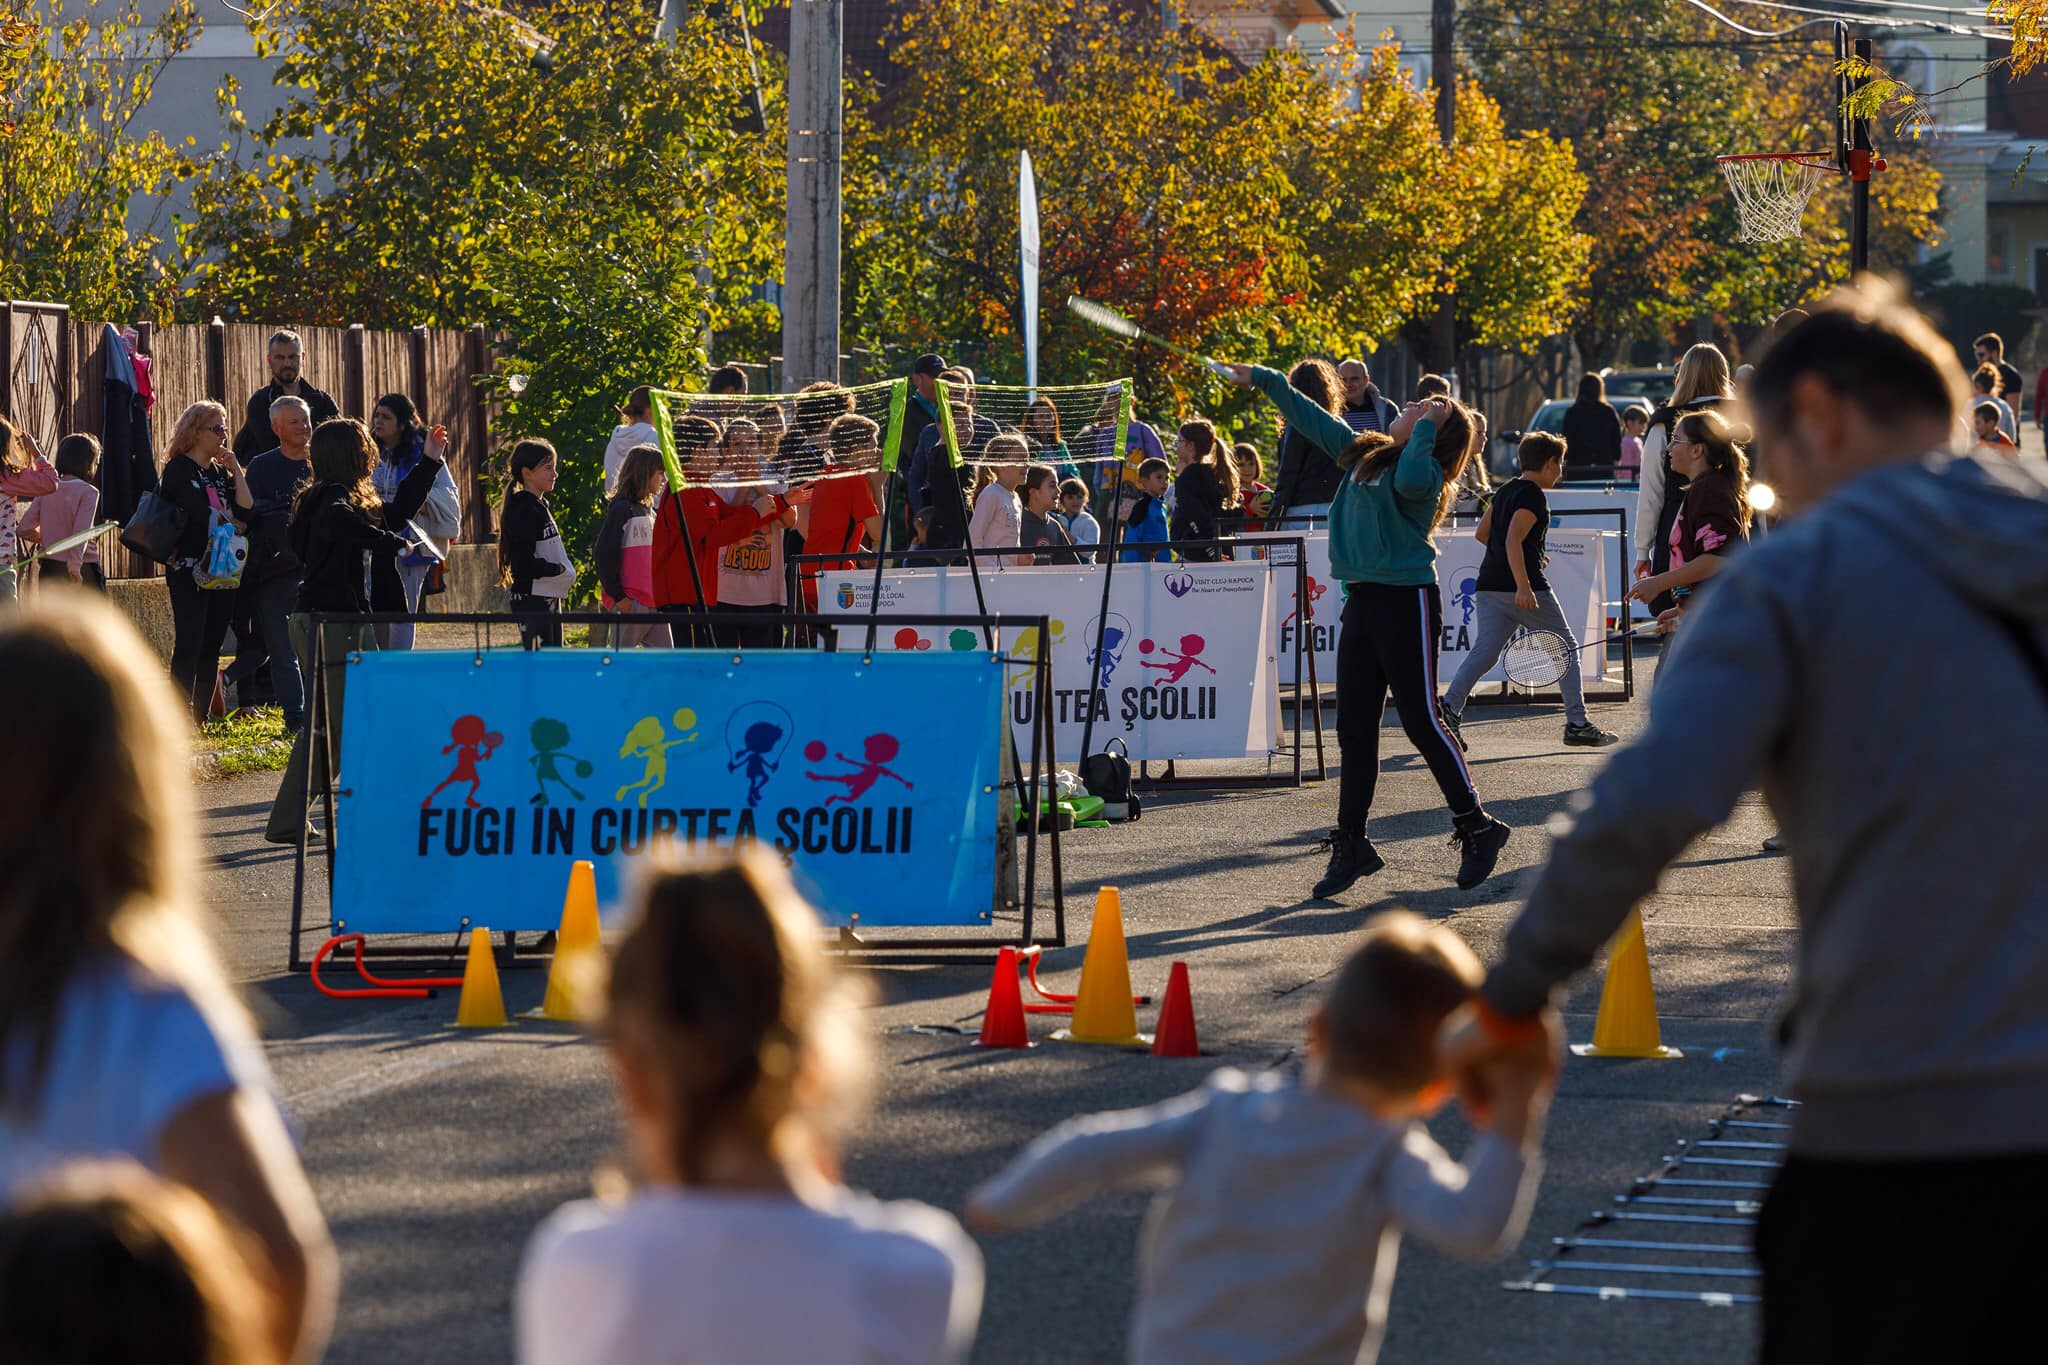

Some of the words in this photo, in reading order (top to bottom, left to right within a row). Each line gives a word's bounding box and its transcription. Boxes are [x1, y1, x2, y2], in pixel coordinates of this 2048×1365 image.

[741, 547, 772, 571] GOOD
[1281, 624, 1335, 653] FGI
[418, 807, 516, 857] FUGI
[591, 808, 757, 857] CURTEA
